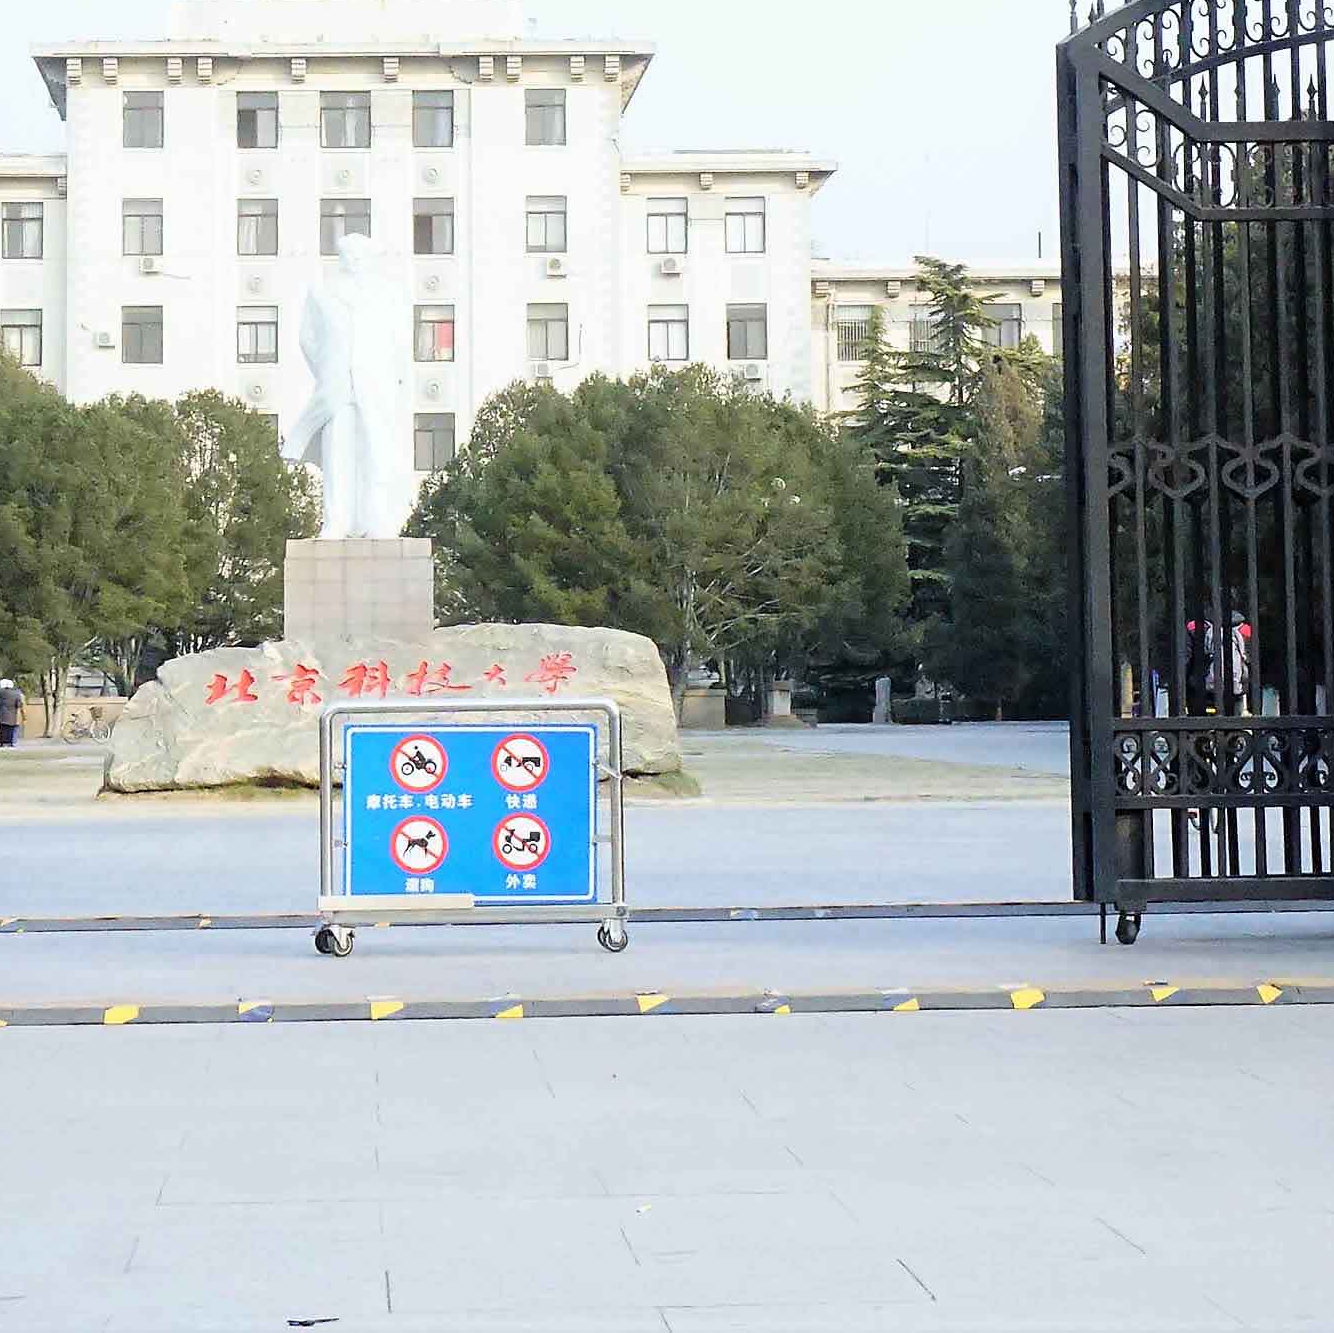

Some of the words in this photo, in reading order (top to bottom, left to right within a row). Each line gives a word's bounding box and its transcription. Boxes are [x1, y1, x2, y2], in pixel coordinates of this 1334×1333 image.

[205, 652, 577, 706] 北京科技大学
[505, 793, 538, 809] 快递
[505, 873, 537, 890] 外卖
